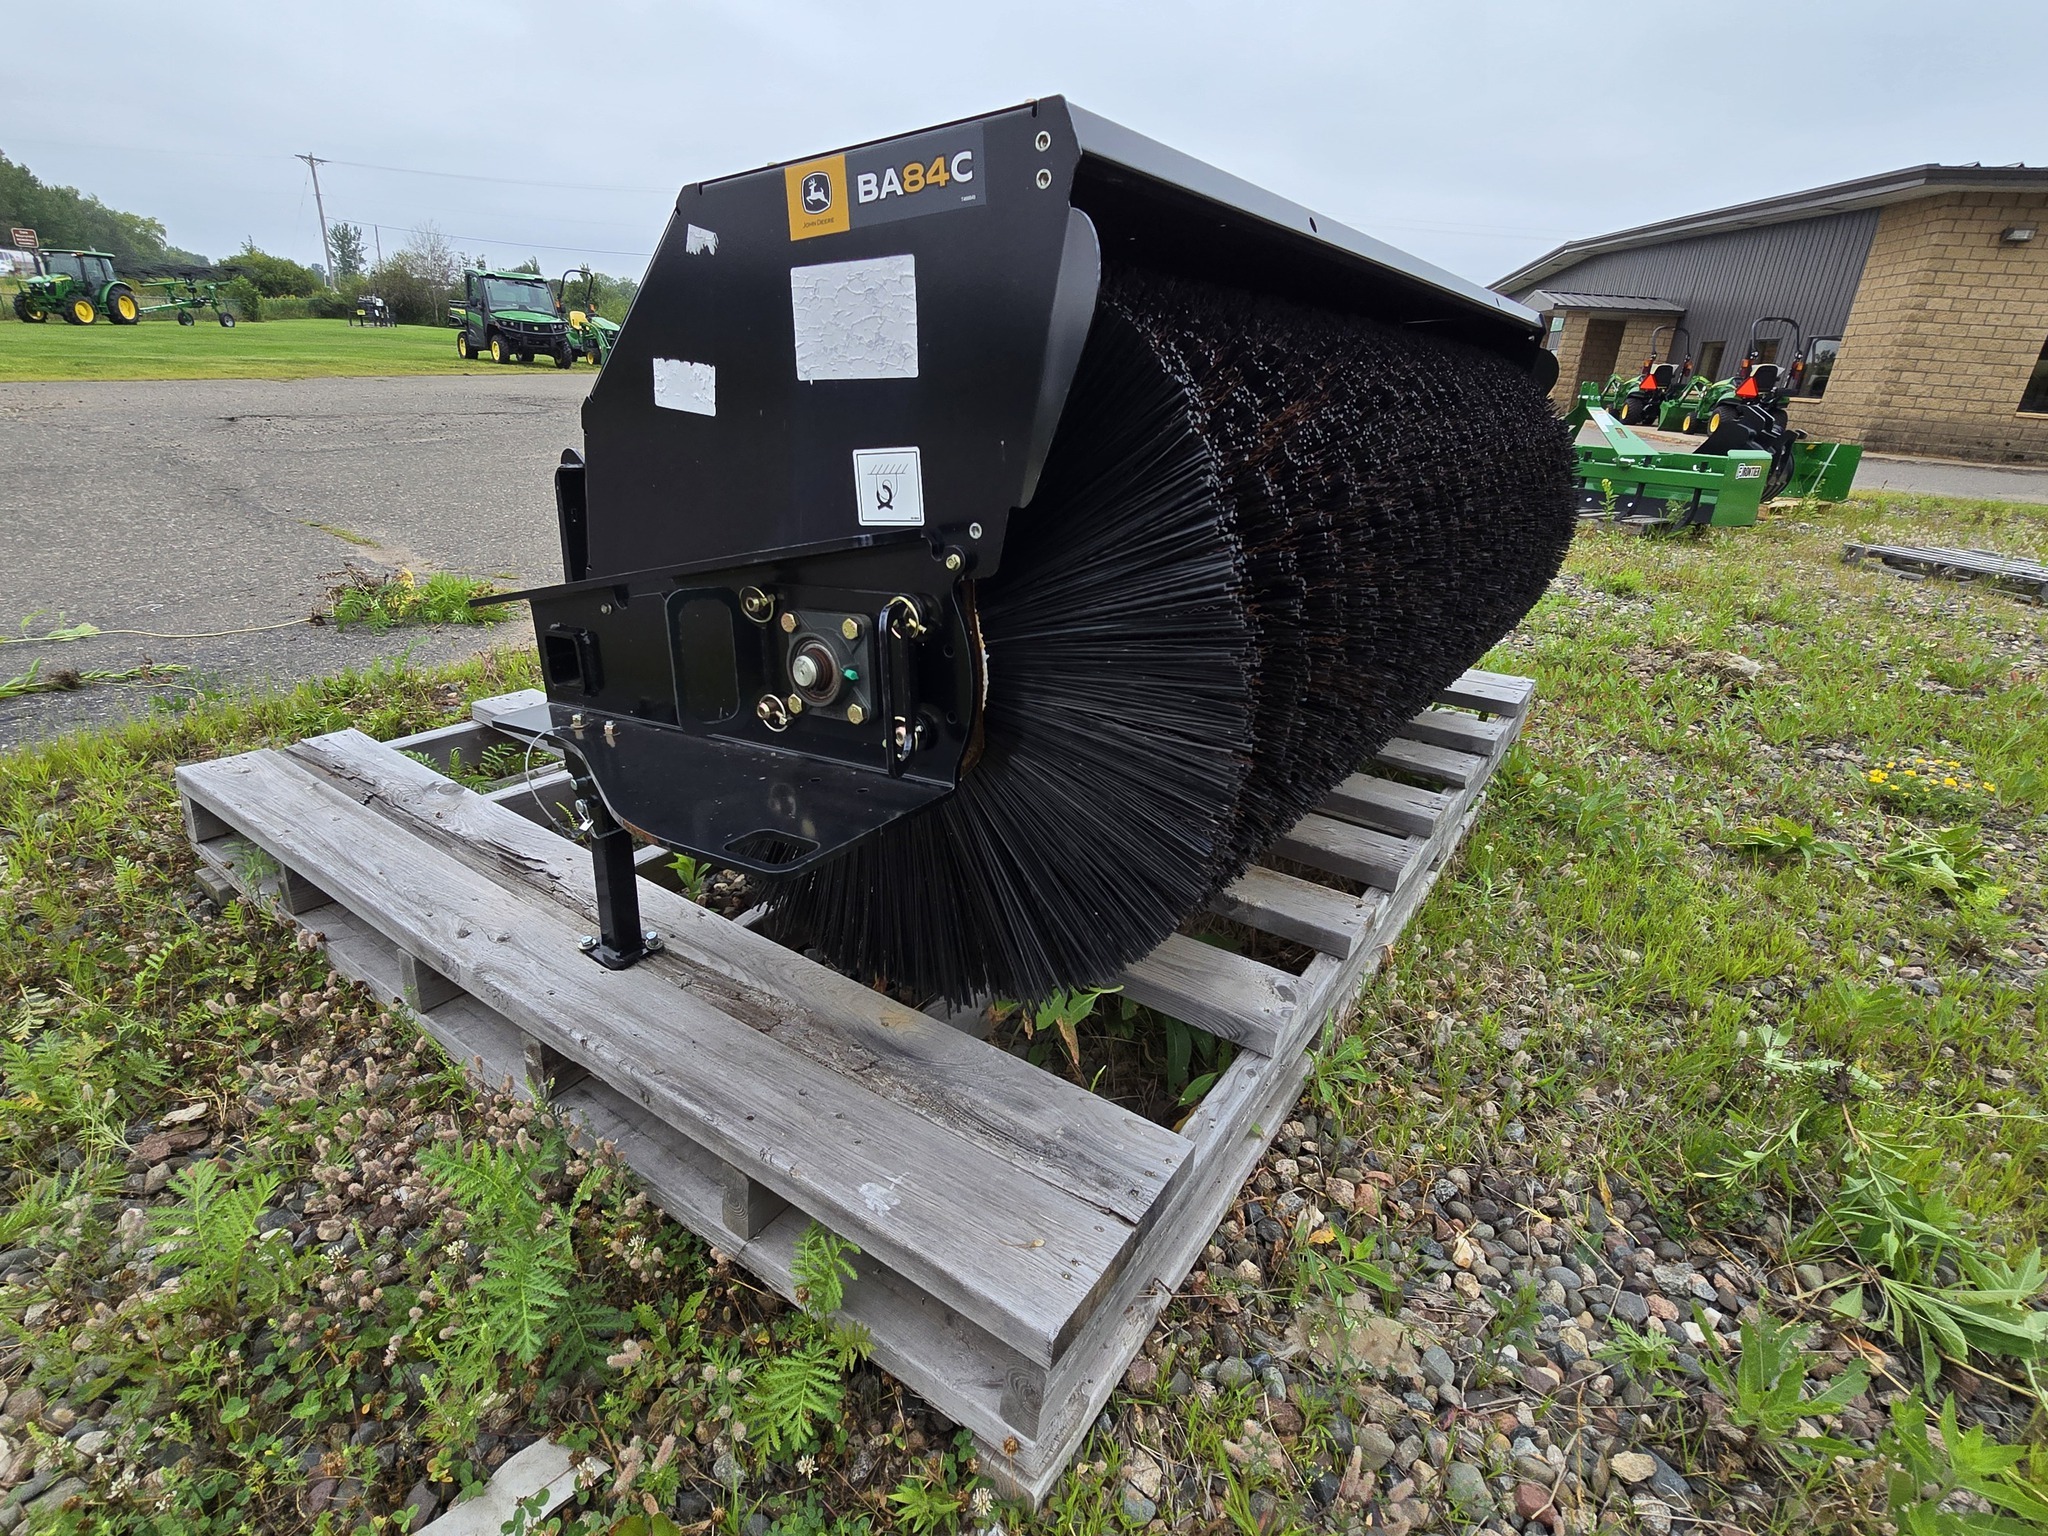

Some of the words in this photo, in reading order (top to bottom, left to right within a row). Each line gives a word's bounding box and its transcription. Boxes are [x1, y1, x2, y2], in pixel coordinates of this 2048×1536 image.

[857, 150, 973, 204] BA84C
[802, 220, 817, 229] JOHN
[816, 216, 835, 226] DEERE
